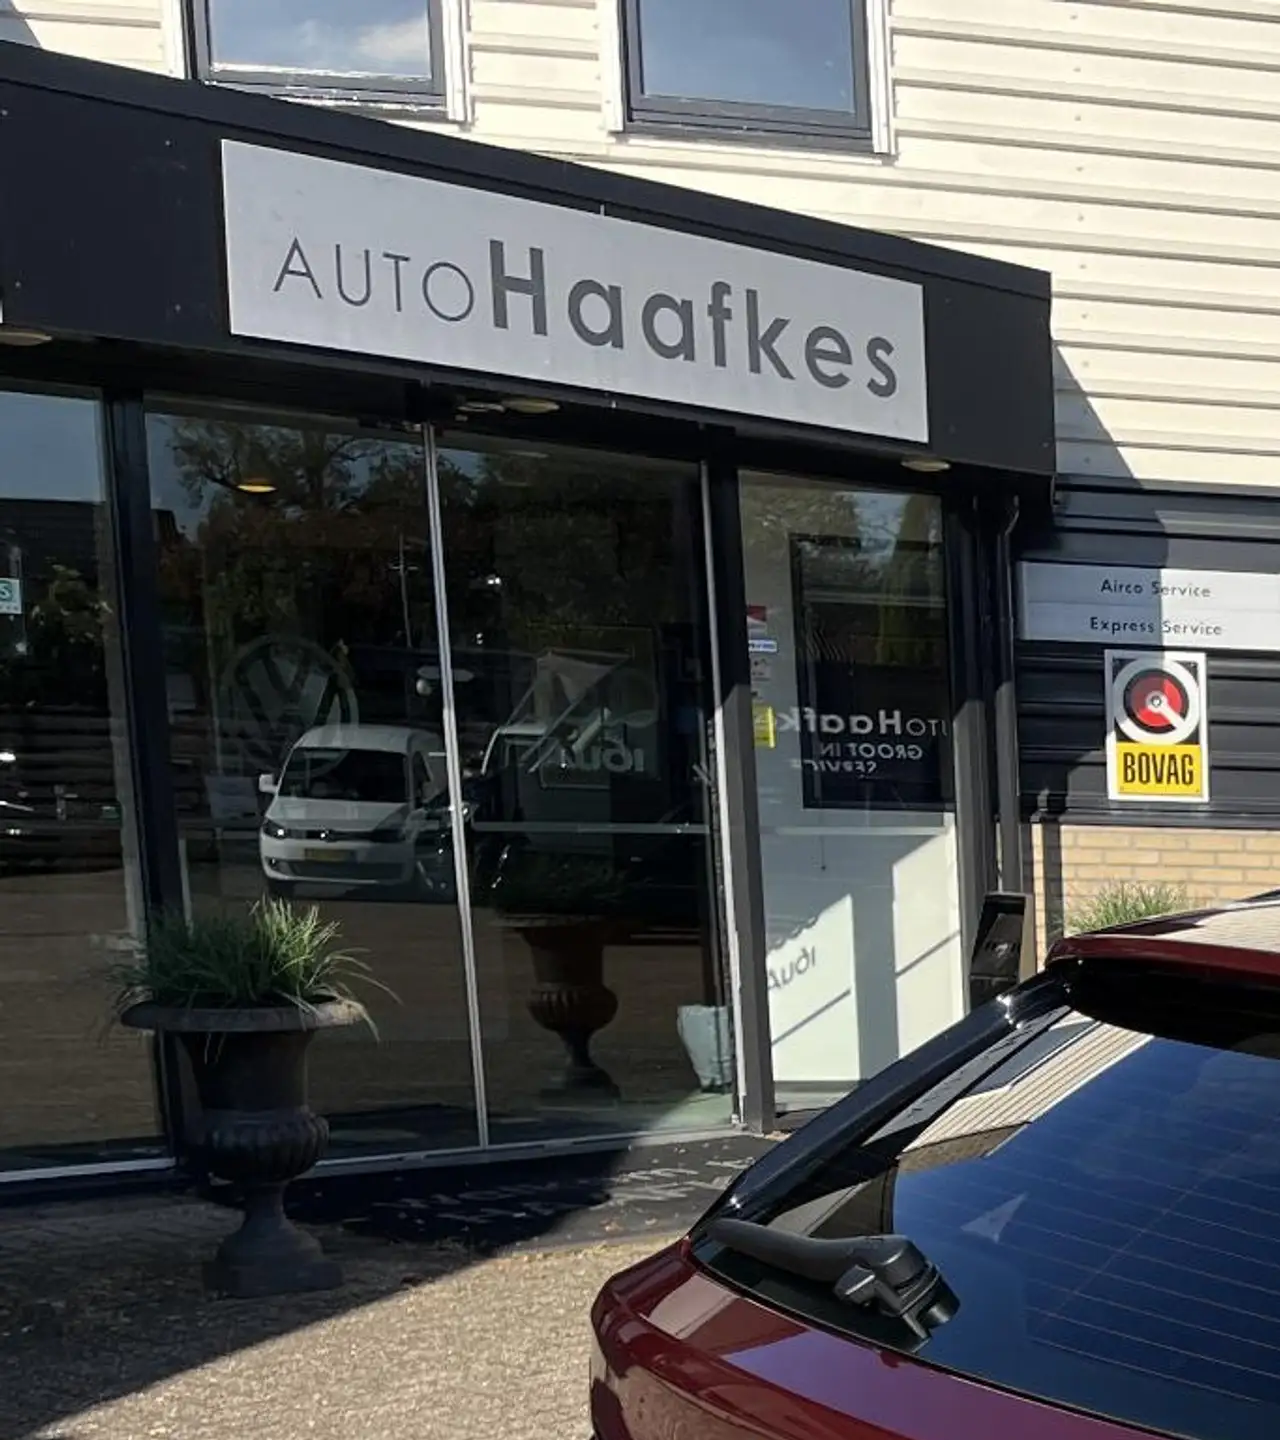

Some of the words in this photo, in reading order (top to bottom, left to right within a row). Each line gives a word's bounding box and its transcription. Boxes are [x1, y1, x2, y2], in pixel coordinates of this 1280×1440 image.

[1100, 578, 1144, 595] Airco
[1151, 581, 1212, 598] Service
[1090, 616, 1155, 634] Express
[1161, 620, 1223, 636] Service
[1122, 752, 1194, 785] BOVAG
